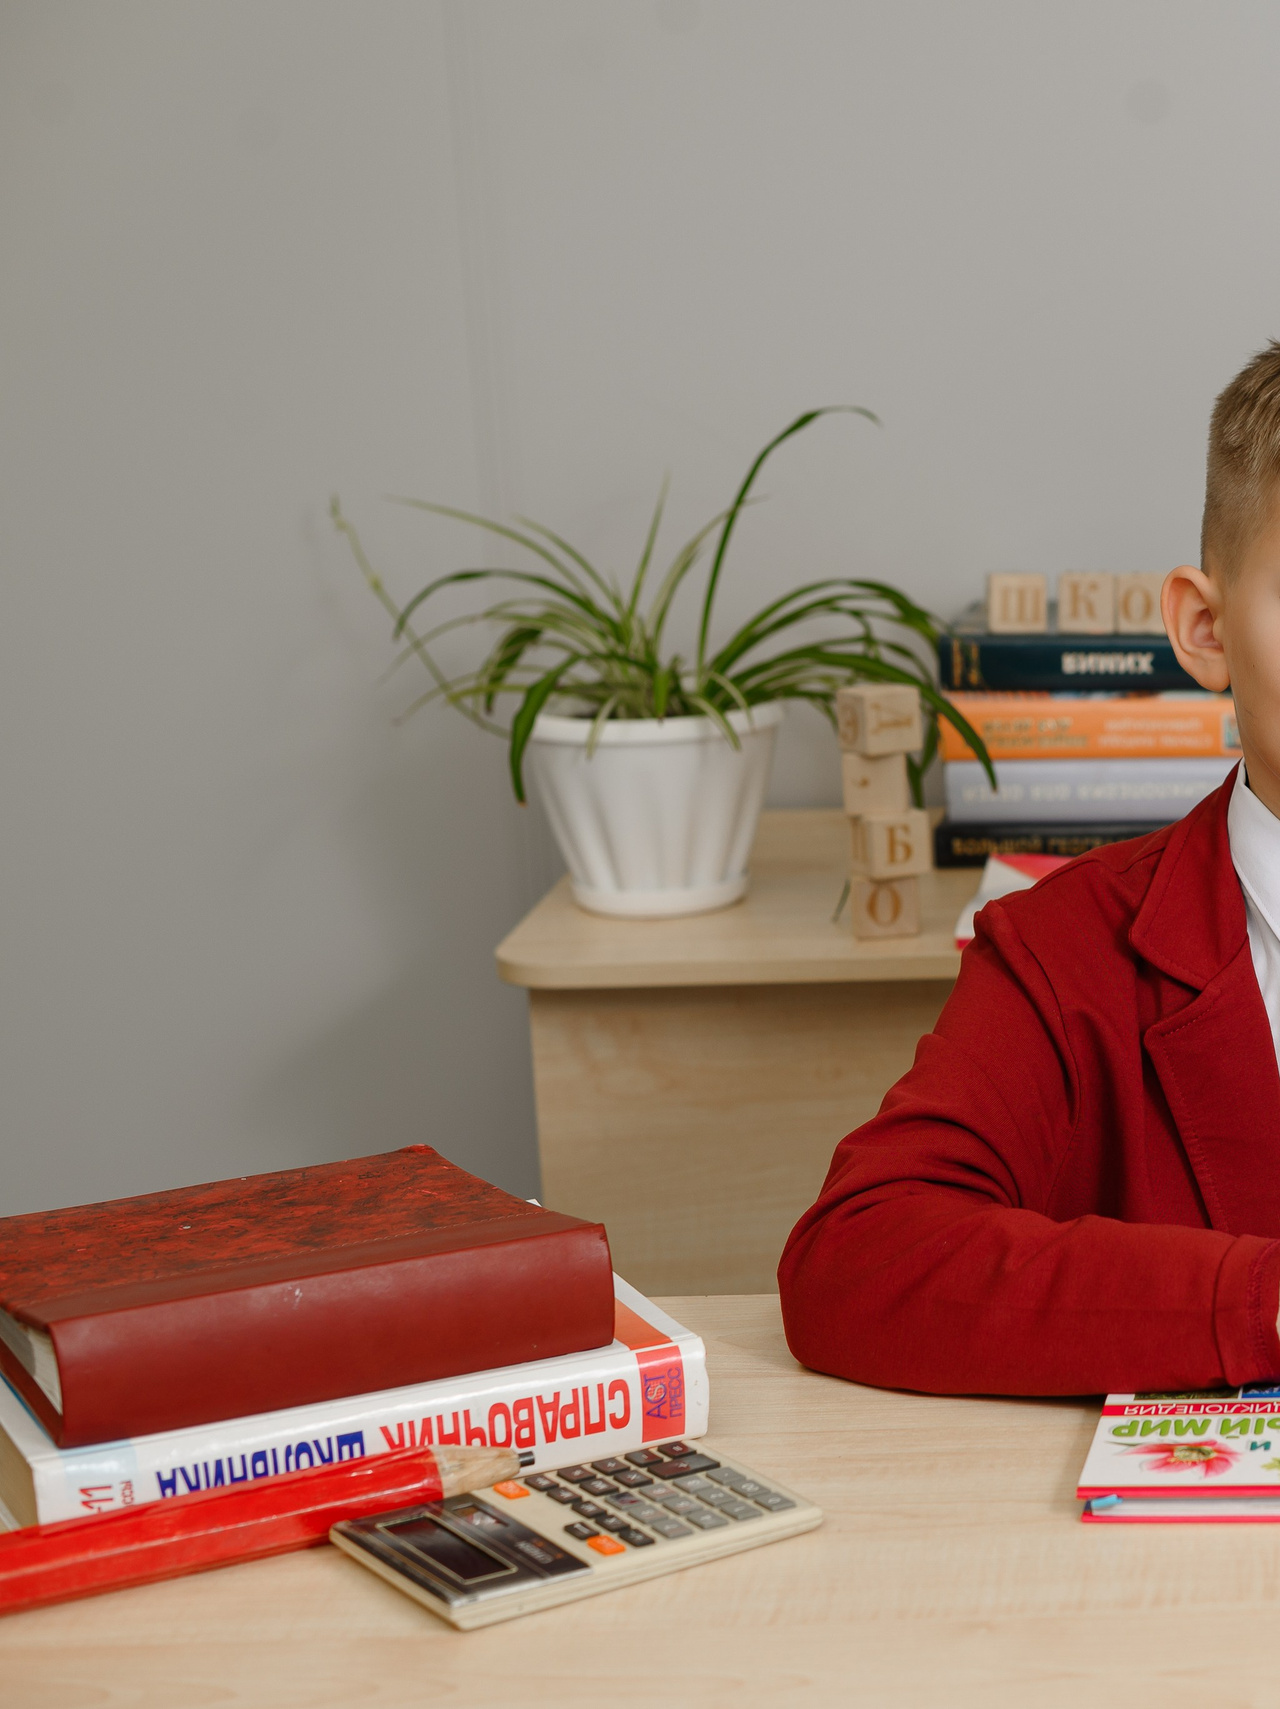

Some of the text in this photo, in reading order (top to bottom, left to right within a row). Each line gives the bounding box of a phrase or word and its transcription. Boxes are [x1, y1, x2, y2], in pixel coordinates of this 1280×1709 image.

[1061, 652, 1154, 675] ХИМИЯ
[668, 1366, 684, 1419] ПРЕСС
[1111, 1417, 1212, 1438] МИР
